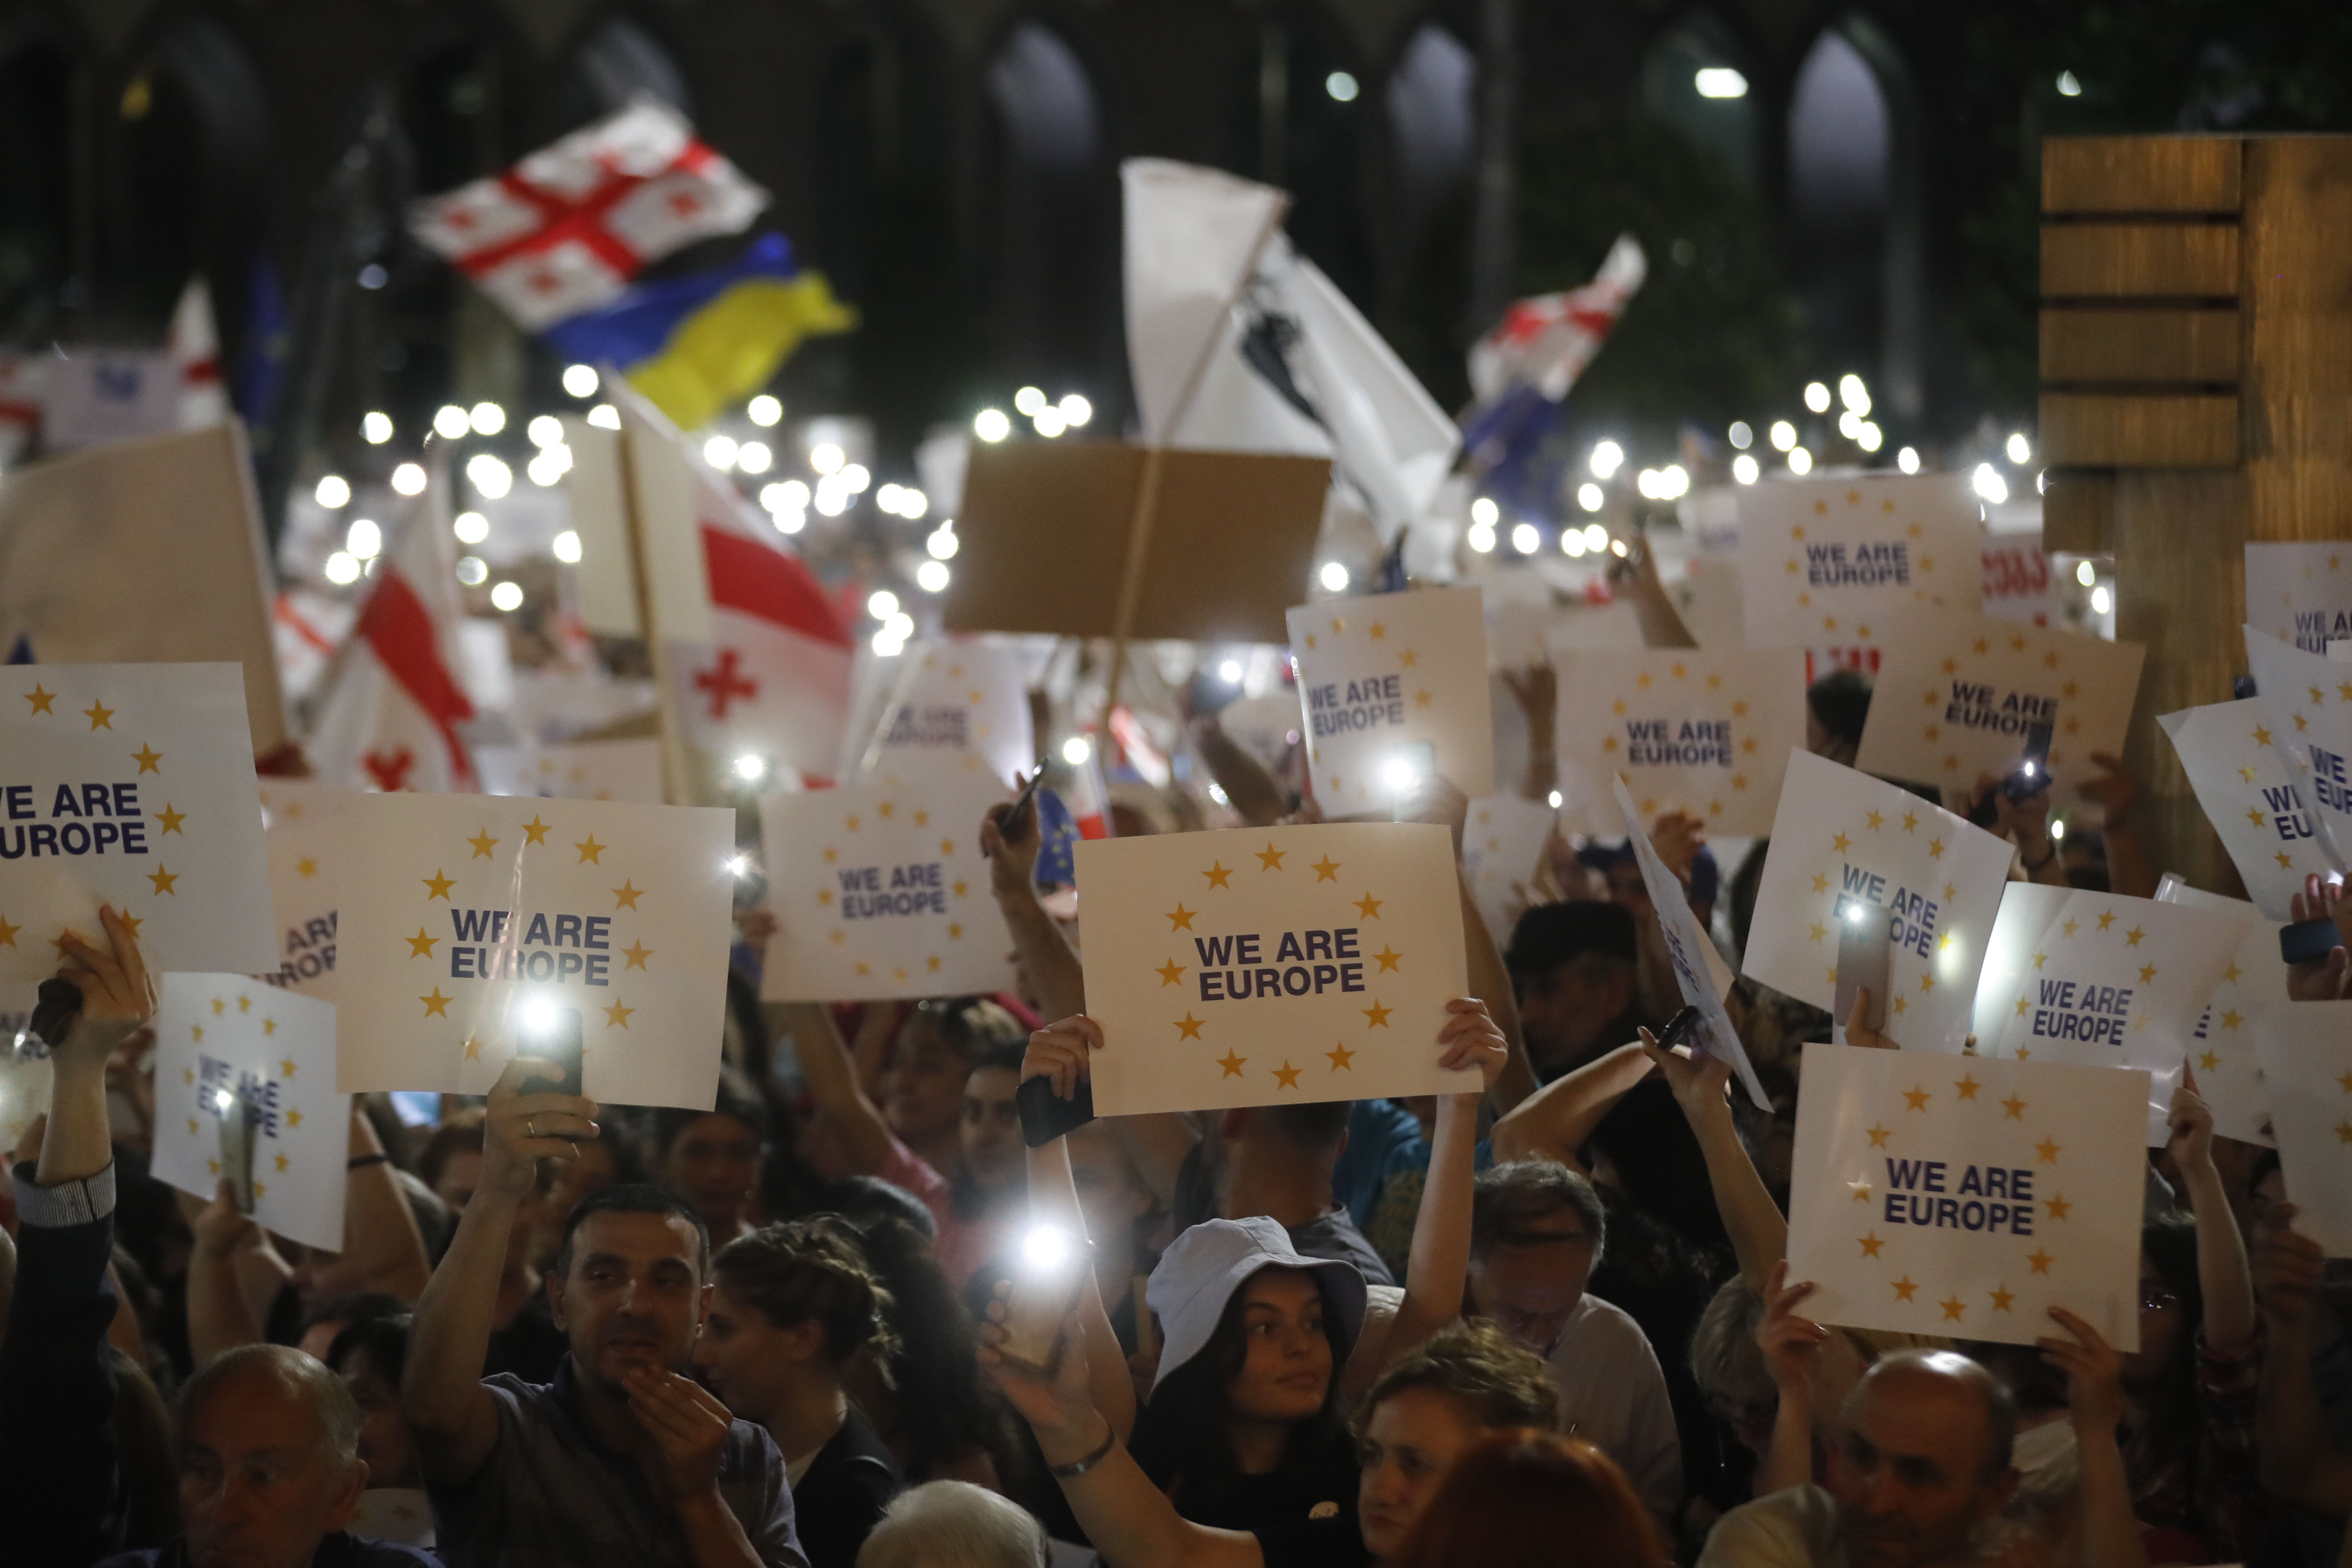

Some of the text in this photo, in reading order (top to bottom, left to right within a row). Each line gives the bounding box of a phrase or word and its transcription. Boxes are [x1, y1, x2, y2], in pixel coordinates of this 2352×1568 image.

[1807, 543, 1908, 563] WE ARE
[1808, 564, 1910, 586] EUROPE
[2295, 610, 2352, 633] WE A
[1308, 675, 1401, 709] WE ARE
[1952, 681, 2058, 723] WE ARE
[1313, 701, 1404, 737] EUROPE
[1627, 720, 1731, 741] WE ARE
[1629, 743, 1732, 766] EUROPE
[2308, 744, 2347, 784] WE
[0, 783, 141, 820] E ARE
[2262, 785, 2302, 813] W
[0, 822, 149, 859] UROPE
[838, 862, 942, 892] WE ARE
[842, 890, 946, 919] EUROPE
[1843, 863, 1938, 930] WE ARE
[451, 908, 611, 949] WE ARE
[1194, 928, 1360, 967] WE ARE
[451, 947, 610, 986] EUROPE
[1199, 963, 1366, 1002] EUROPE
[2040, 979, 2133, 1016] WE ARE
[2032, 1010, 2126, 1046] EUROPE
[1885, 1157, 2033, 1201] WE ARE
[1884, 1192, 2034, 1235] EUROPE
